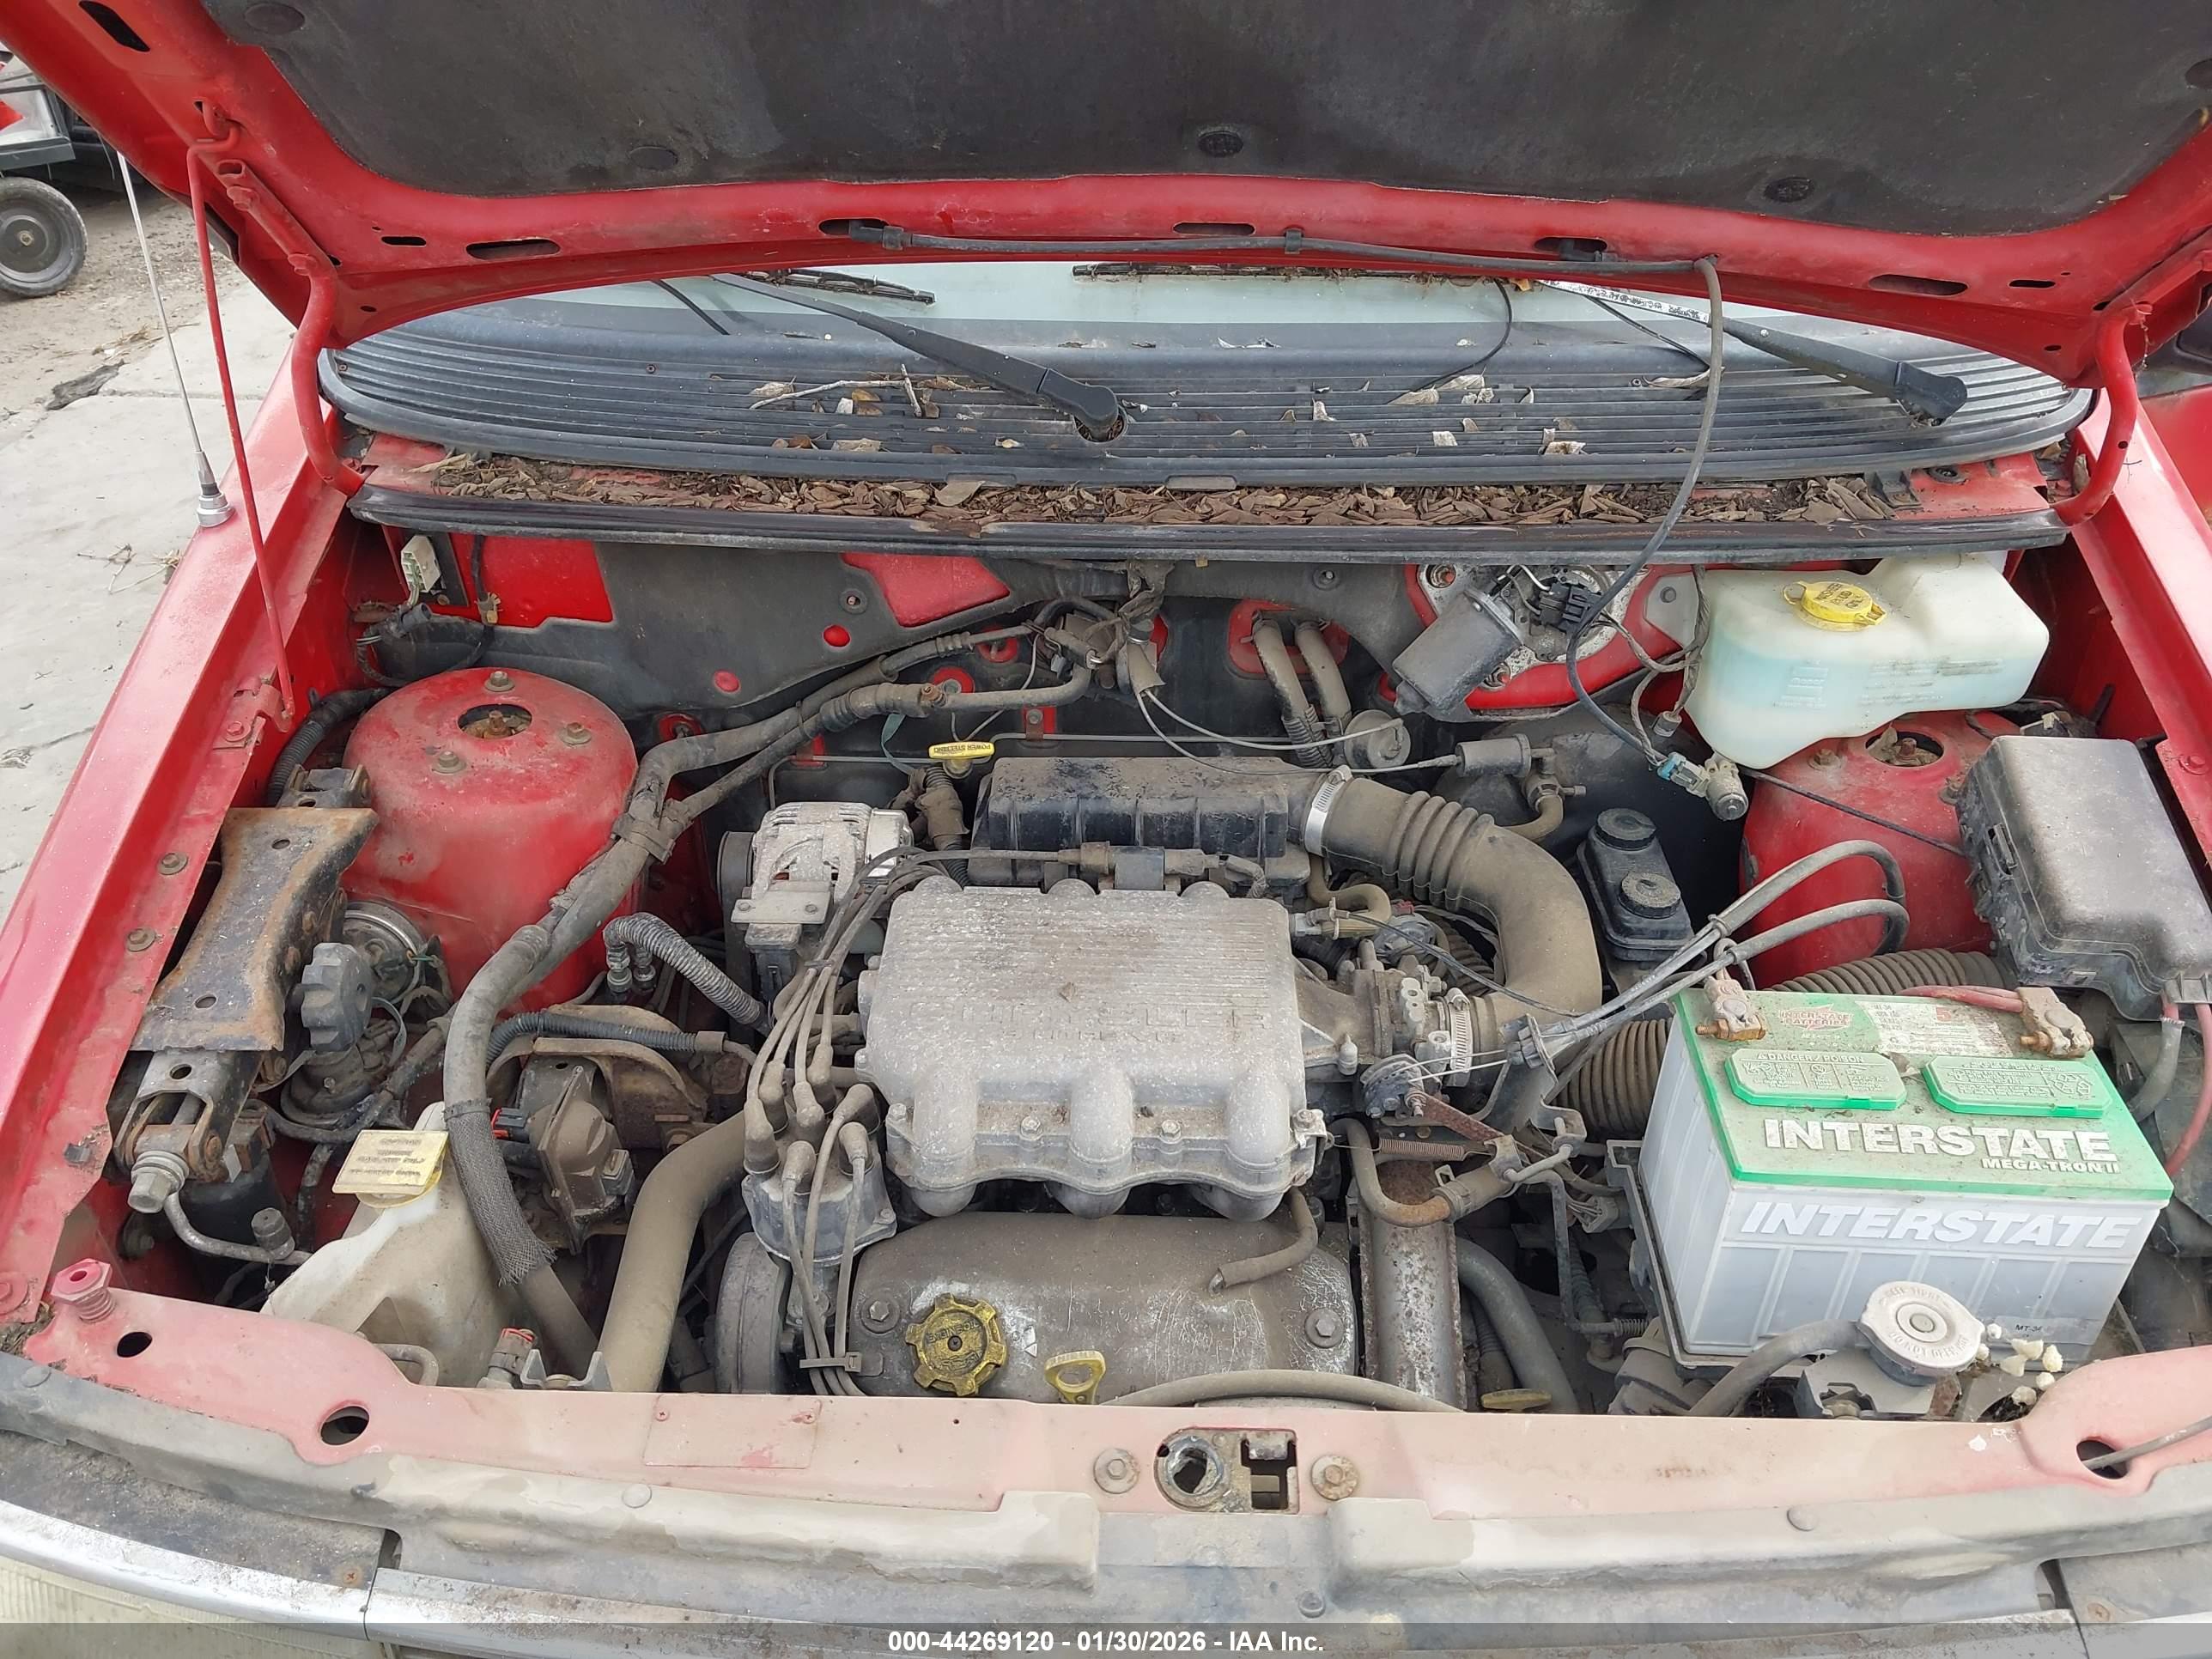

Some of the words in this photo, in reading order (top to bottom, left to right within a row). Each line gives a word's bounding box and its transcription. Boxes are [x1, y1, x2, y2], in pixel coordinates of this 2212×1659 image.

[1780, 1010, 1850, 1021] INTERSTATE
[1823, 1054, 1864, 1063] POISON
[1764, 1119, 2118, 1163] INTERSTATE
[1741, 1201, 2143, 1249] INTERSTATE
[927, 1323, 963, 1344] ENGINE
[963, 1319, 982, 1332] OIL
